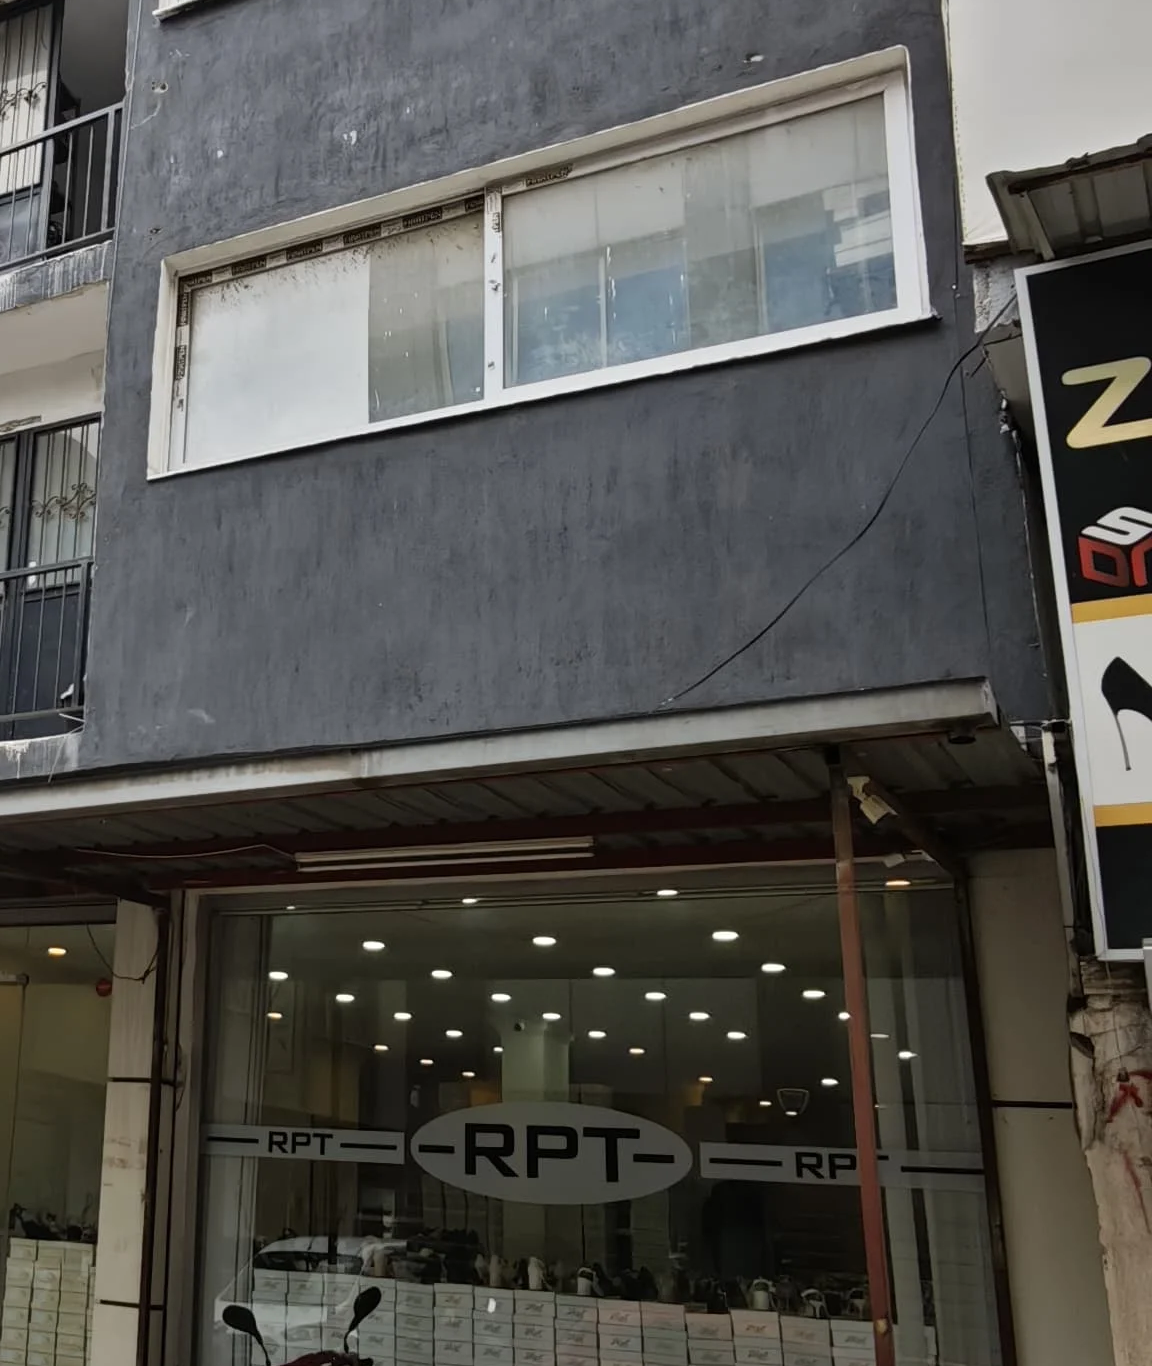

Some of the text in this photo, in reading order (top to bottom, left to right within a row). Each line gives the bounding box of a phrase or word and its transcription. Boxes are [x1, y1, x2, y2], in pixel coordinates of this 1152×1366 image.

[268, 1131, 334, 1155] RPT
[464, 1122, 641, 1183] RPT
[794, 1151, 890, 1180] RP
